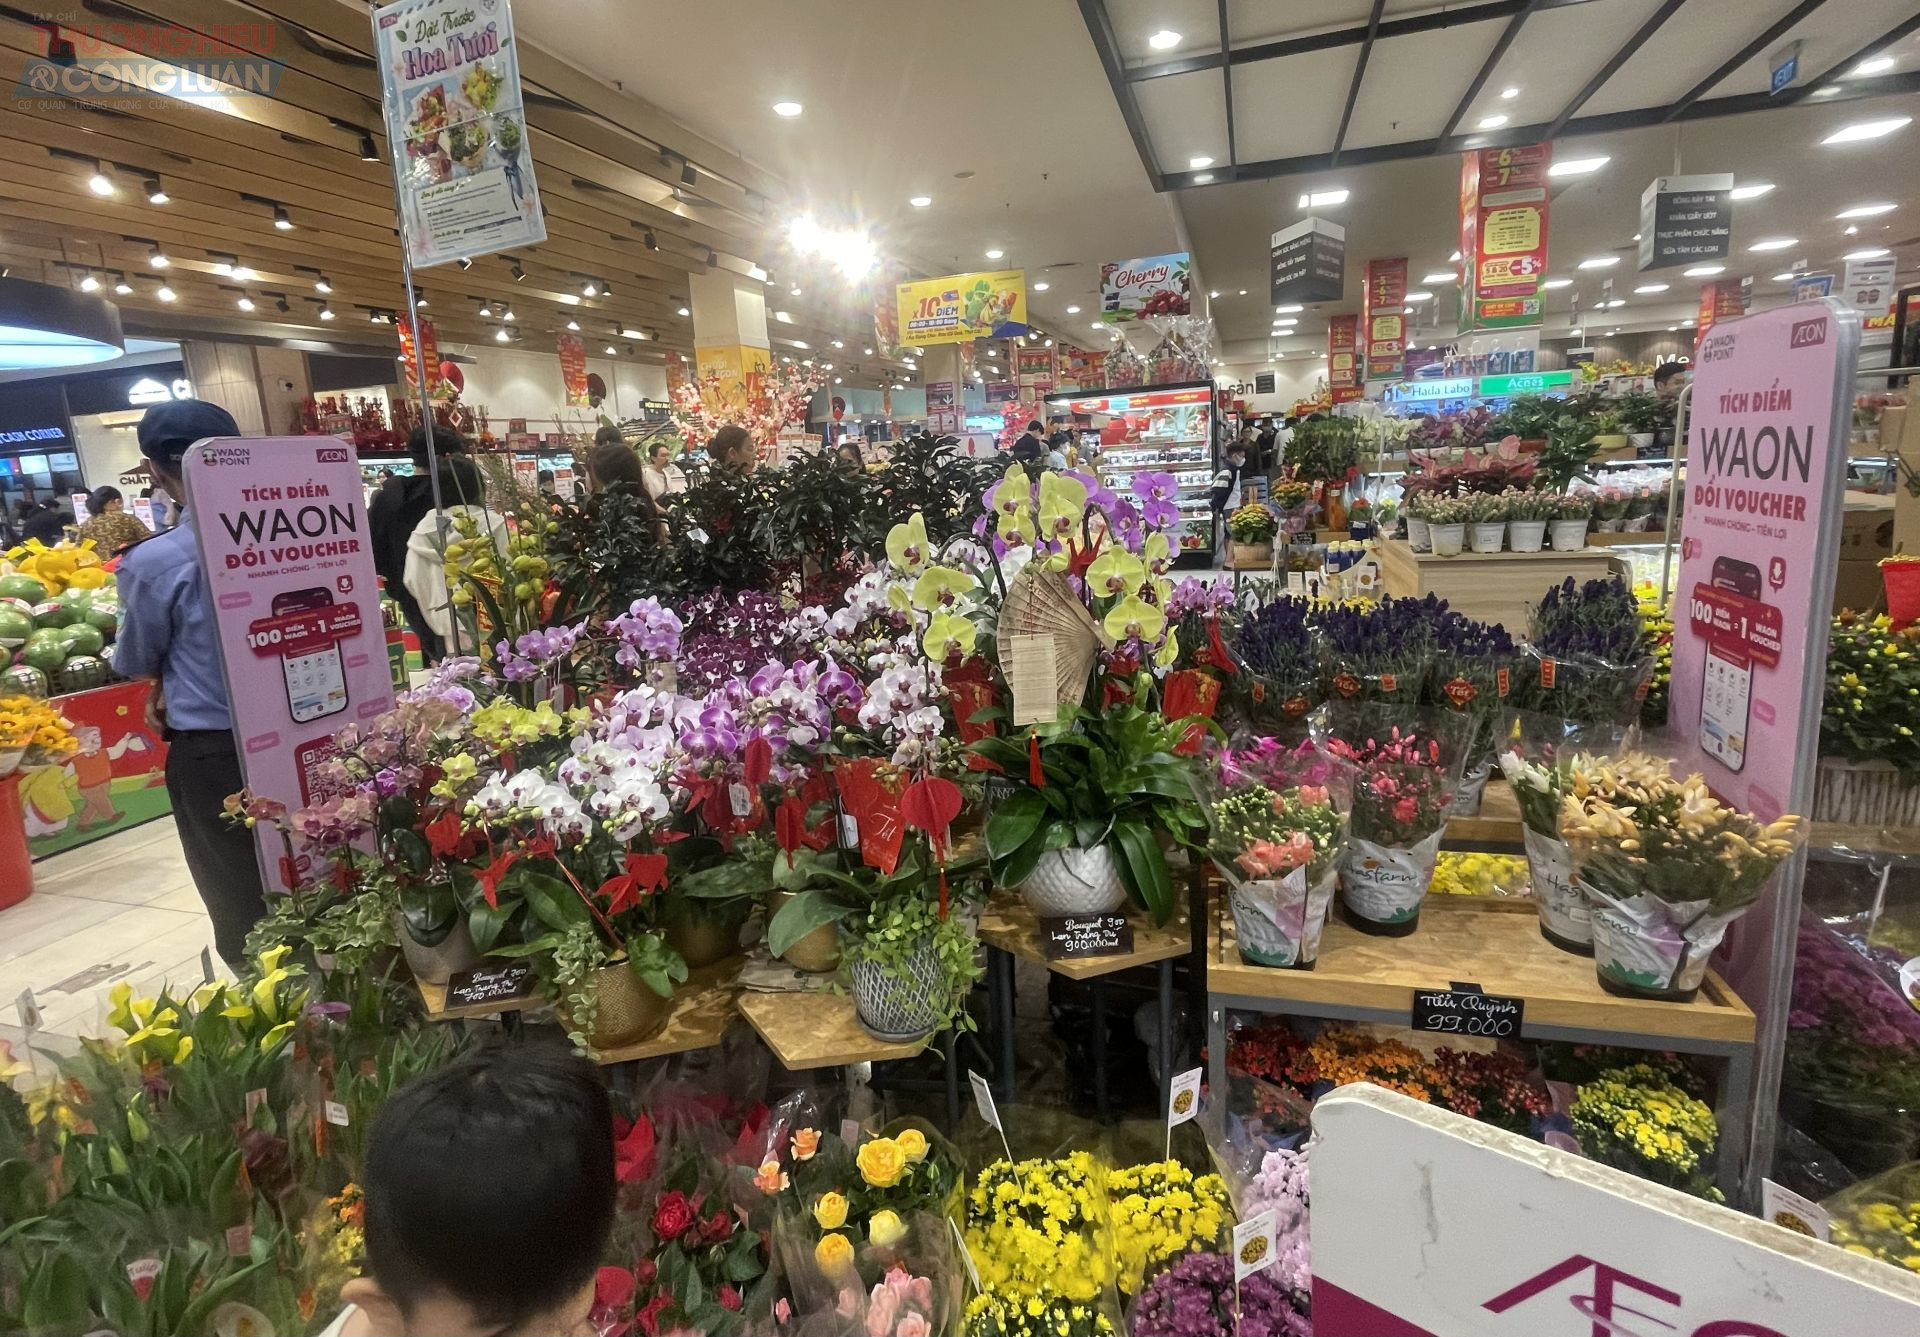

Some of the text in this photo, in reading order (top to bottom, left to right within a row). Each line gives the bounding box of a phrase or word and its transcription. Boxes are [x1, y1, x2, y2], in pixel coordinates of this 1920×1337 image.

[402, 21, 499, 80] Hoa Tươi
[1660, 179, 1668, 191] 2
[1115, 265, 1169, 290] Cherry
[1713, 347, 1735, 361] POINT
[1412, 383, 1470, 397] Hada Labo
[1720, 377, 1791, 414] TÍCH ĐIỂM
[25, 427, 65, 440] CORNER
[216, 448, 250, 457] WAON
[1701, 425, 1813, 483] WAON
[219, 457, 250, 466] POINT
[242, 478, 330, 502] TÍCH ĐIỂM
[1694, 474, 1806, 521] ĐỔI VOUCHER
[219, 502, 357, 546] WAON
[225, 539, 361, 570] ĐỔI VOUCHER
[248, 568, 279, 579] NHANH
[329, 618, 361, 630] VOUCHER
[334, 614, 356, 623] WAON
[1690, 598, 1712, 624] 100
[1741, 616, 1748, 639] 1
[247, 628, 282, 649] 100
[317, 619, 327, 633] 1
[284, 630, 308, 640] WAON
[1755, 622, 1777, 638] WAON
[1749, 631, 1782, 653] VOUCHER
[1065, 916, 1125, 933] Bouquet 900
[1051, 930, 1072, 941] Lan
[1074, 930, 1101, 941] Trang
[453, 986, 472, 995] Lan
[1460, 995, 1518, 1018] Quỳnh
[1424, 1013, 1513, 1036] 99.000
